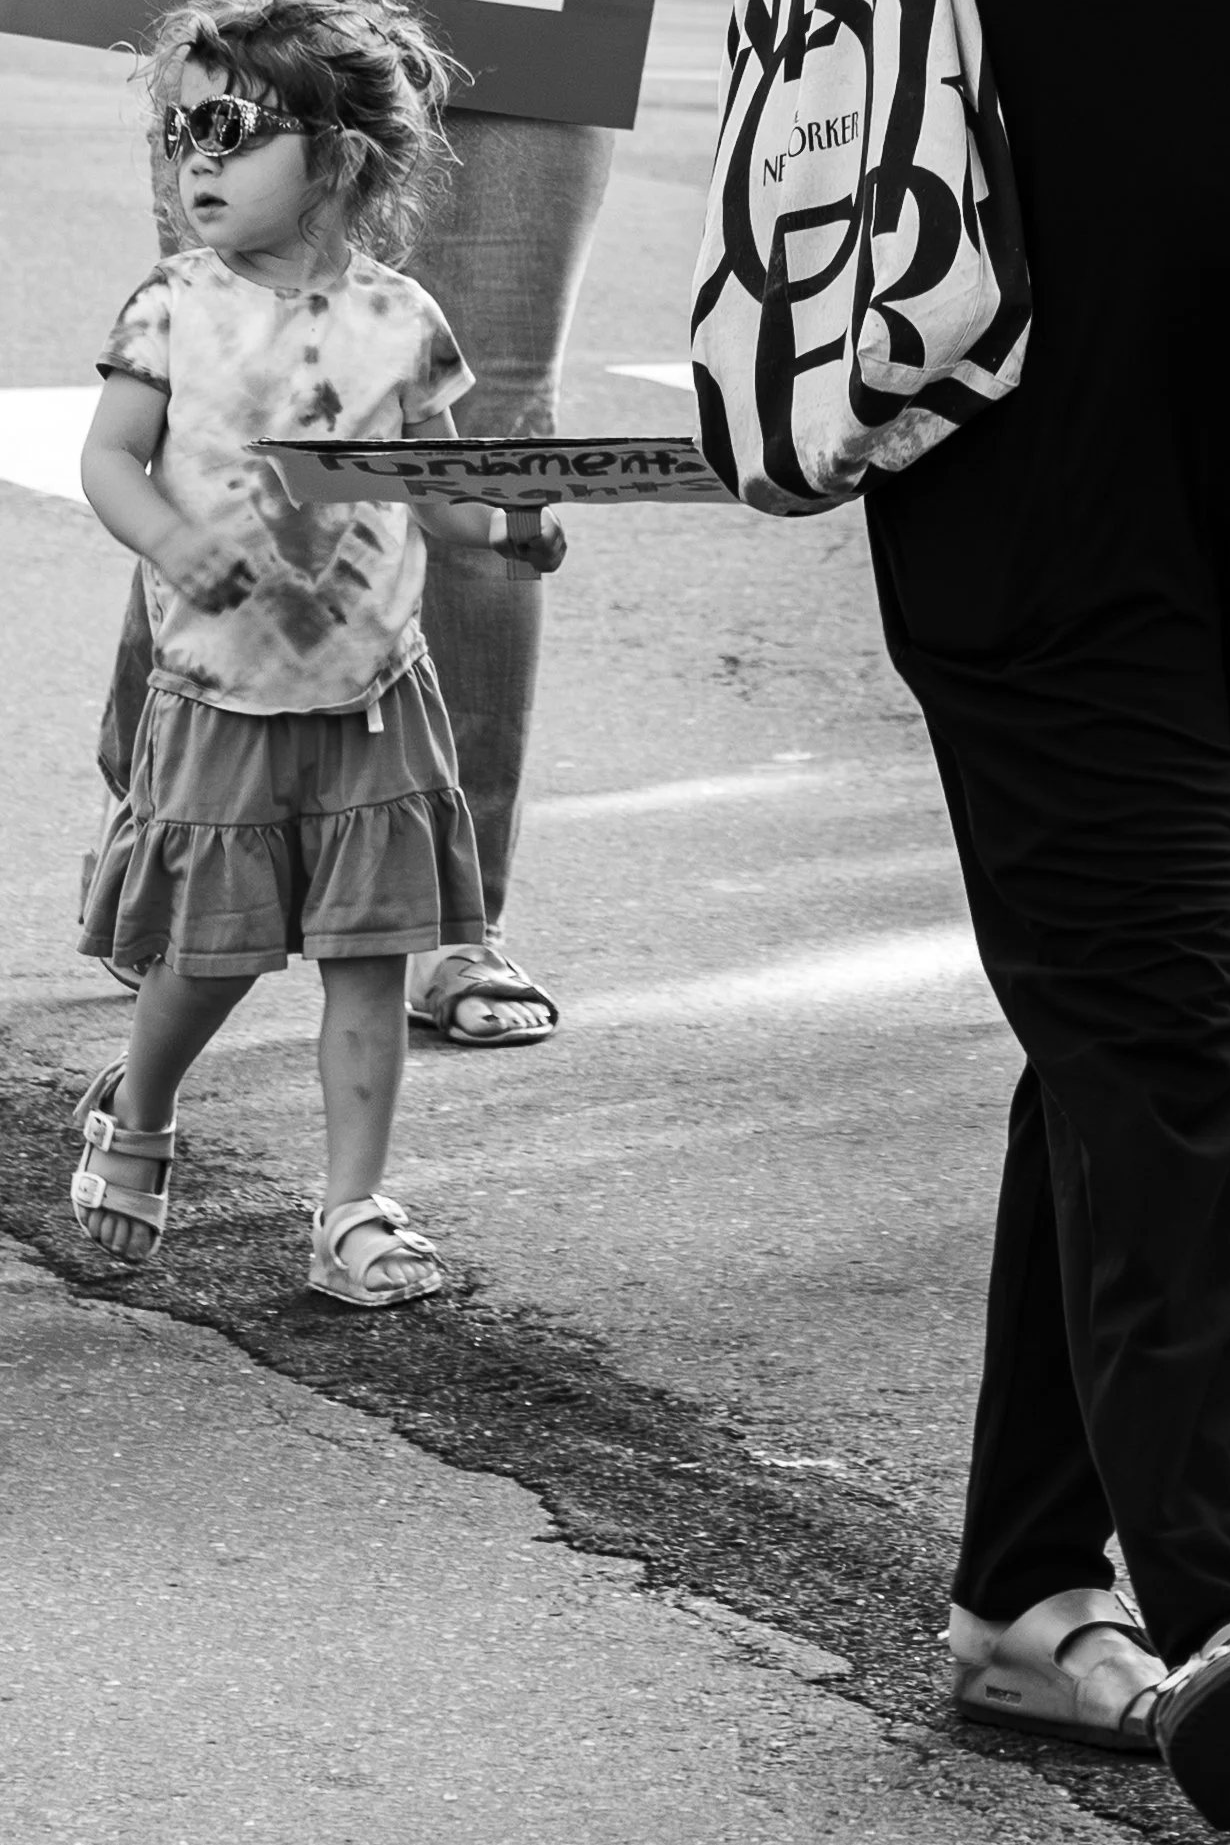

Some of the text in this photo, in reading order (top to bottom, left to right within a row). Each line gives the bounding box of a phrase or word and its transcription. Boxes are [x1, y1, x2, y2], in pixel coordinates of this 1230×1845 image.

[788, 111, 858, 157] ORKER
[763, 153, 787, 186] NE
[317, 449, 708, 477] Fundamenta
